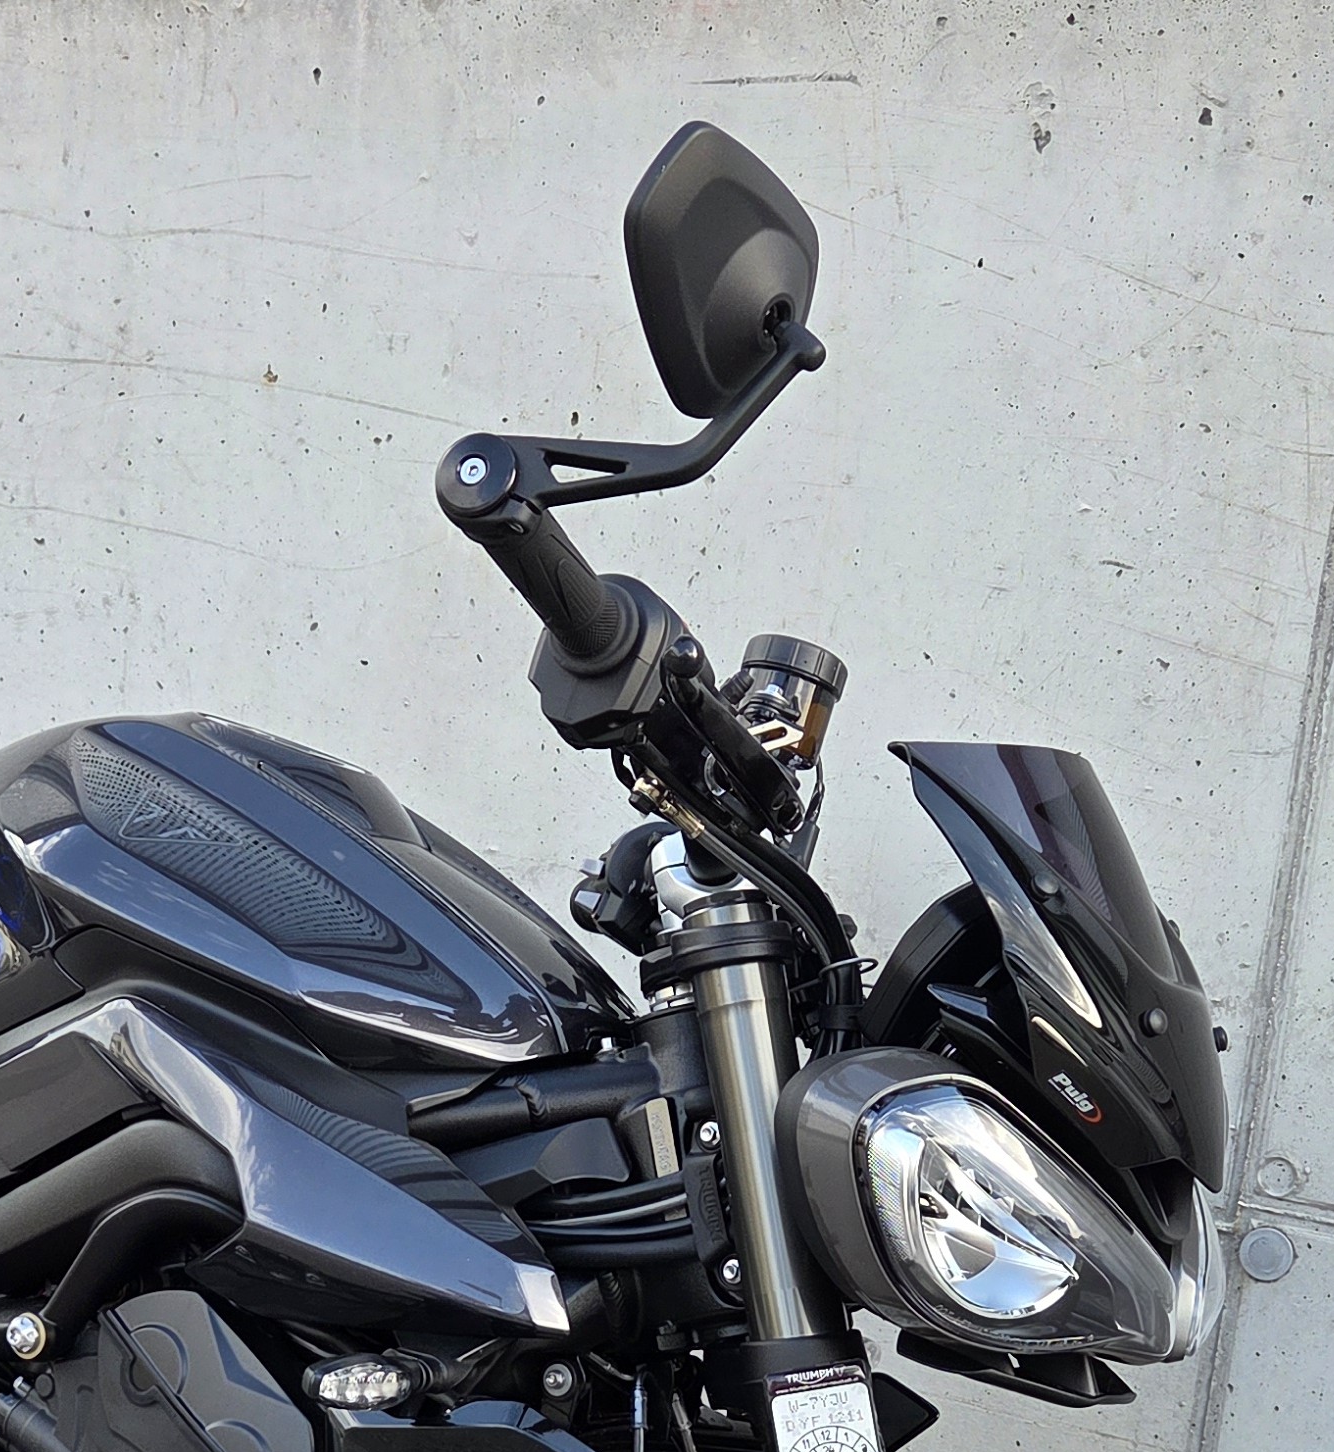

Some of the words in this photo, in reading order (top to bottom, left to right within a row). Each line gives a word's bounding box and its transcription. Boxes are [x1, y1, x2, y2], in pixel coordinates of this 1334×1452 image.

[1051, 1072, 1095, 1113] Puig
[785, 1367, 834, 1385] TRIUMPH
[821, 1429, 832, 1440] 12
[802, 1439, 811, 1449] 11
